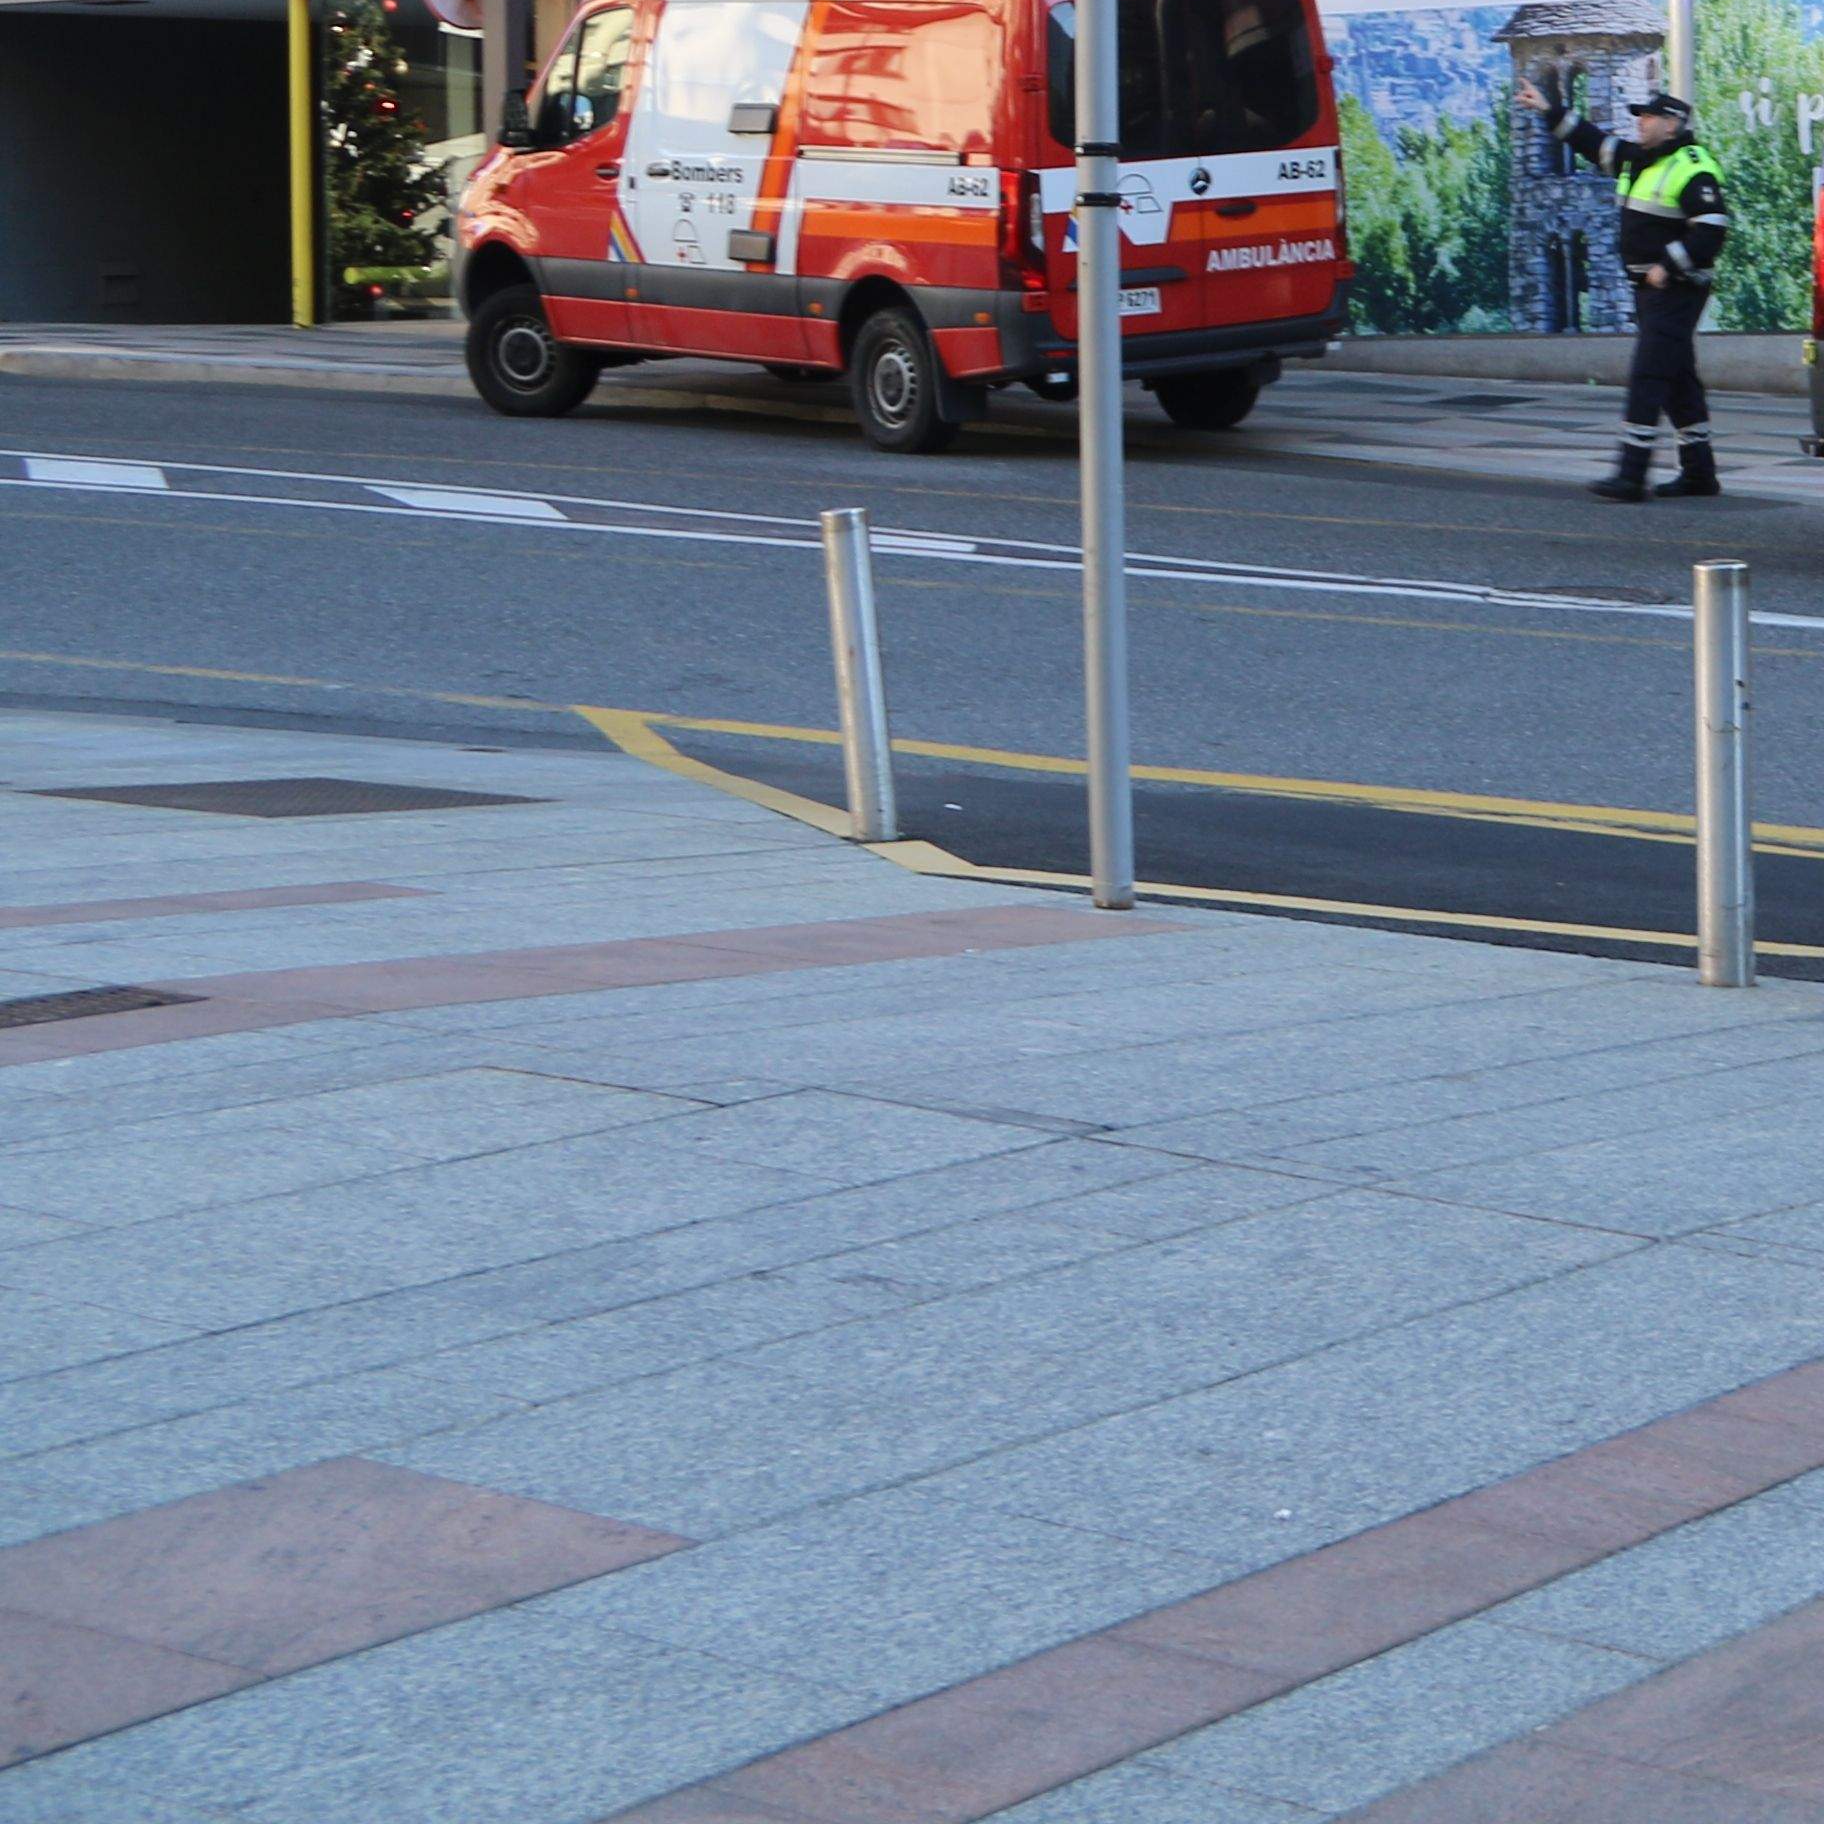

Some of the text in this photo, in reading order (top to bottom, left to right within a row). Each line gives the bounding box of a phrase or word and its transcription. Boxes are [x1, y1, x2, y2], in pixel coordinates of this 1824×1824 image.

[672, 160, 744, 183] Bombers
[1278, 159, 1327, 182] AB-62
[947, 176, 990, 200] AB-62
[1205, 238, 1337, 273] AMBULÀNCIA
